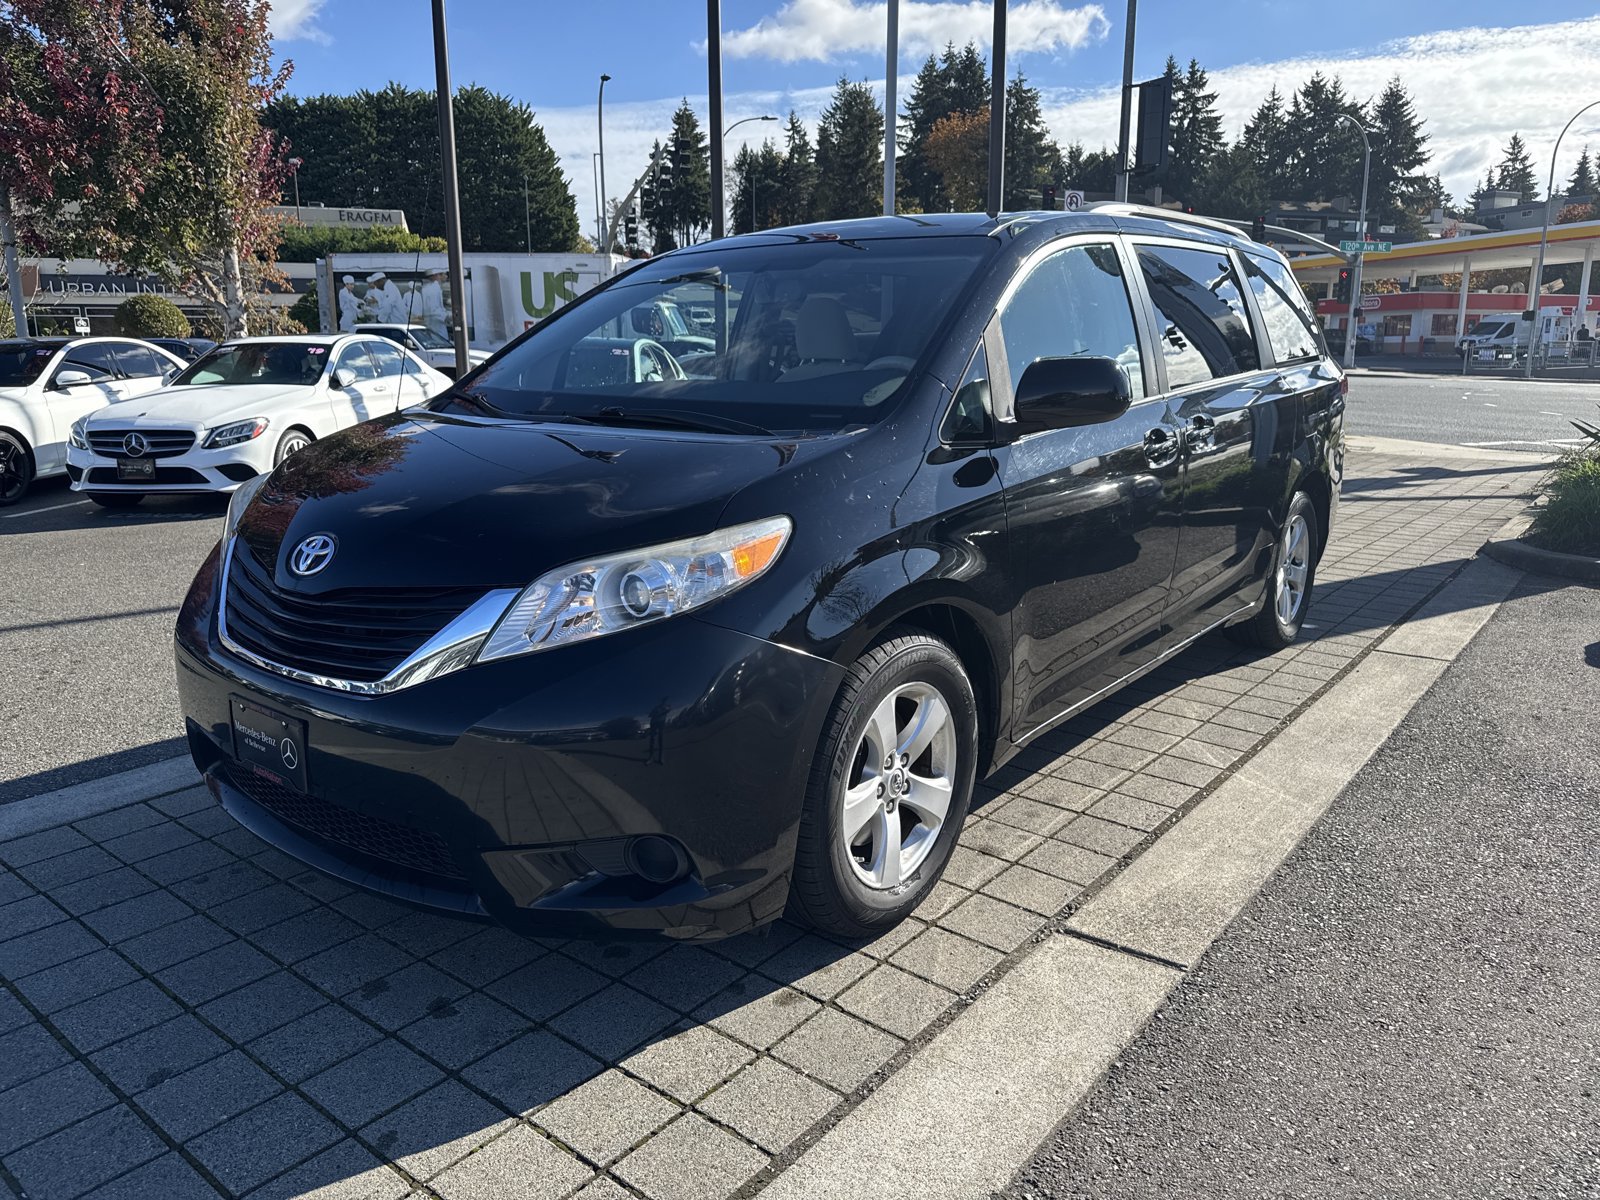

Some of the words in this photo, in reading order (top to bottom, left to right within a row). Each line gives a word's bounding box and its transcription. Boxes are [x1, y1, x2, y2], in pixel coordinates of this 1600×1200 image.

[1345, 242, 1360, 251] 120th
[1363, 243, 1375, 251] Ave
[1378, 243, 1387, 252] NE
[49, 280, 126, 297] URBAN
[234, 720, 277, 746] Mercedes-Benz
